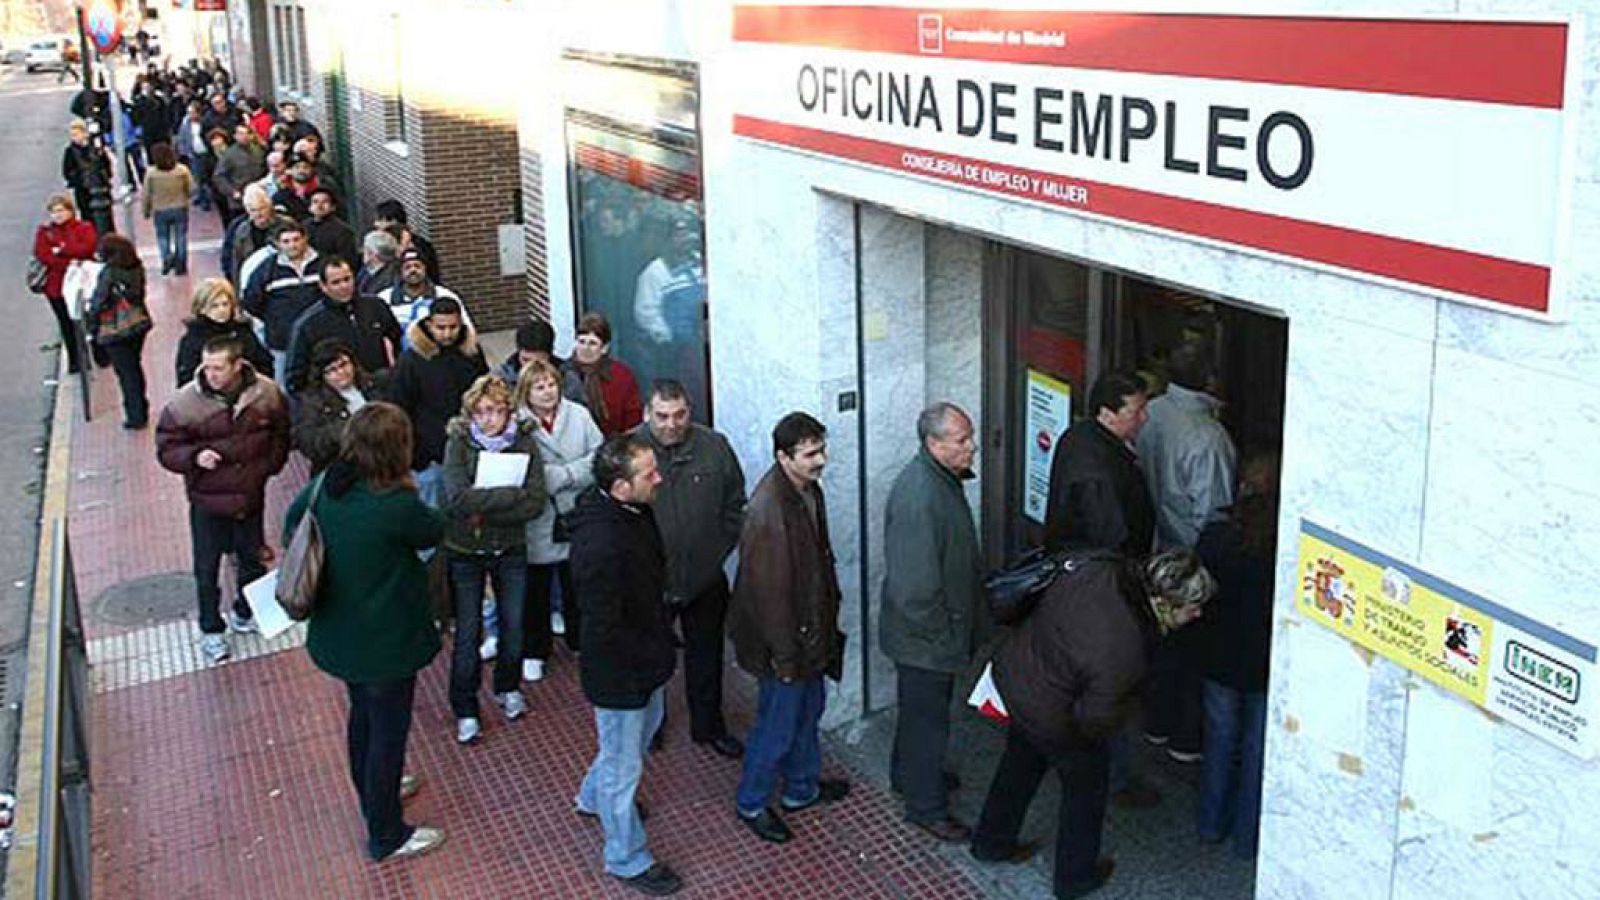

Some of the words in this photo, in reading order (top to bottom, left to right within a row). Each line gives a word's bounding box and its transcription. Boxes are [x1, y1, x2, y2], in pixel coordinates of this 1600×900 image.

[945, 27, 1005, 44] Comunidad
[1023, 30, 1066, 47] Madrid
[797, 64, 943, 132] OFICINA
[957, 79, 1018, 145] DE
[1034, 87, 1314, 191] EMPLEO
[964, 165, 981, 182] DE
[982, 168, 1030, 192] EMPLEO
[1031, 178, 1041, 193] Y
[1042, 181, 1088, 204] MUJER
